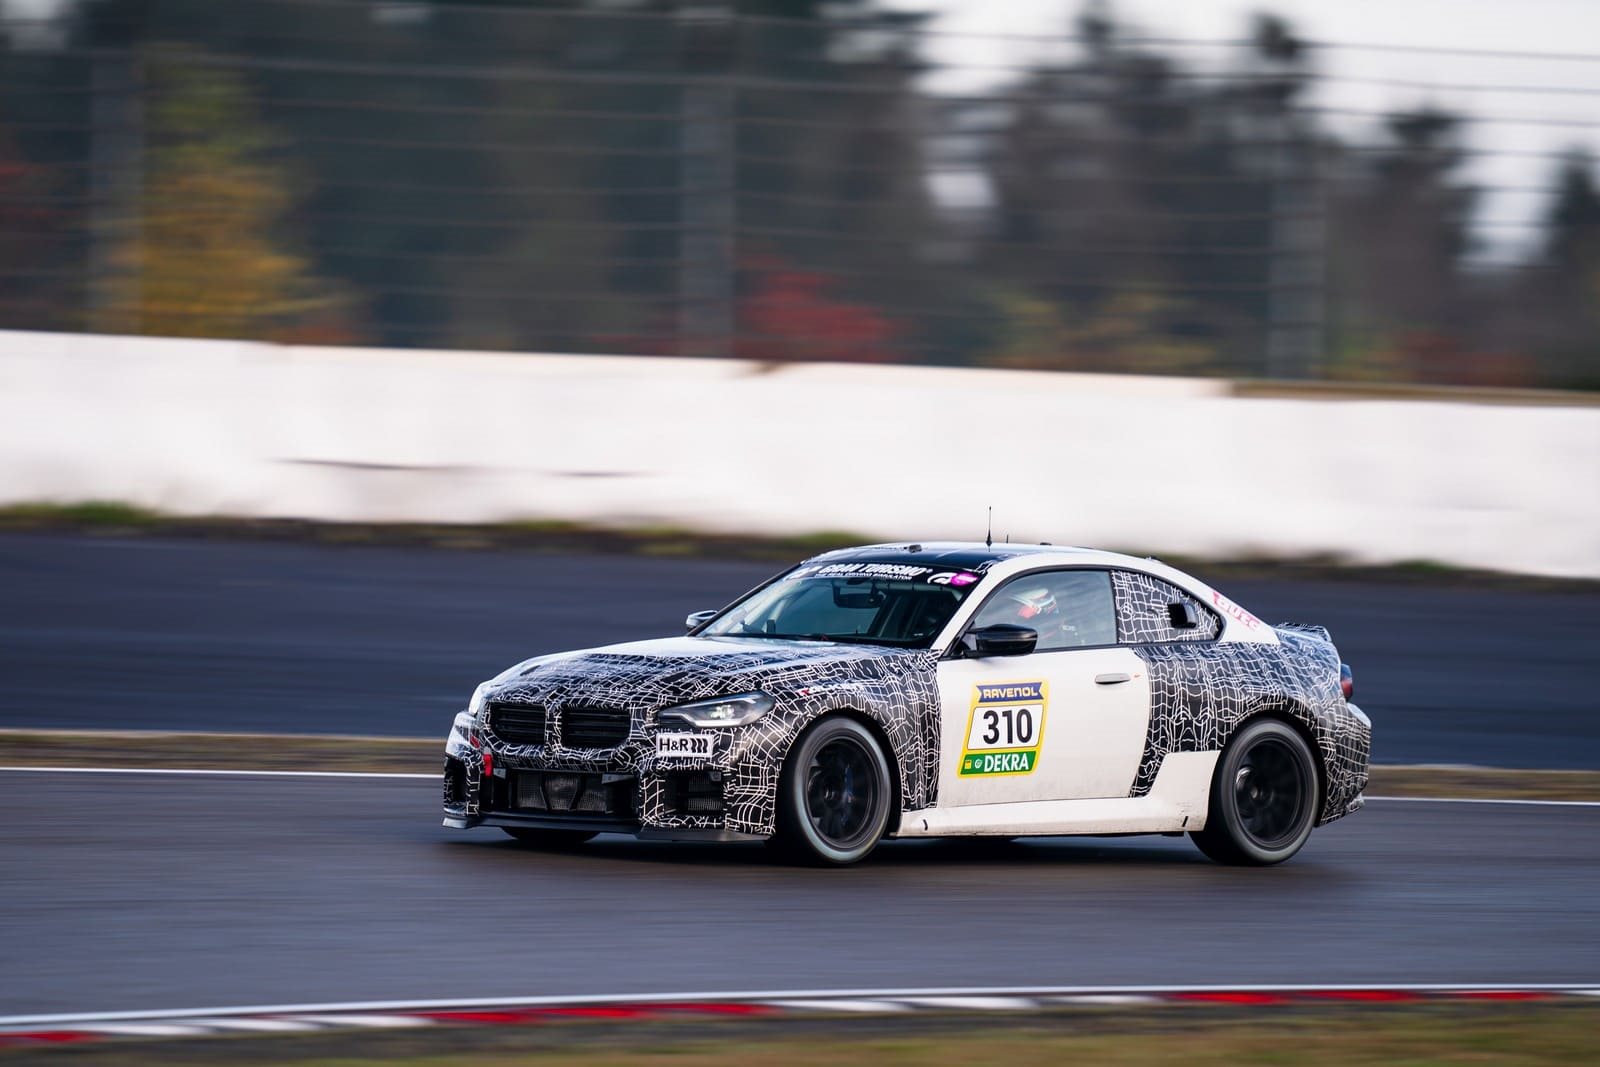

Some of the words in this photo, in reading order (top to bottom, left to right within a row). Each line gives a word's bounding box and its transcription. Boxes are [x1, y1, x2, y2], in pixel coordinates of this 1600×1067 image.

[819, 564, 865, 574] GRAN
[859, 564, 927, 576] TURISMO
[982, 686, 1039, 699] RAVENOL
[982, 708, 1033, 745] 310
[659, 737, 689, 752] H&R
[983, 752, 1030, 773] DEKRA
